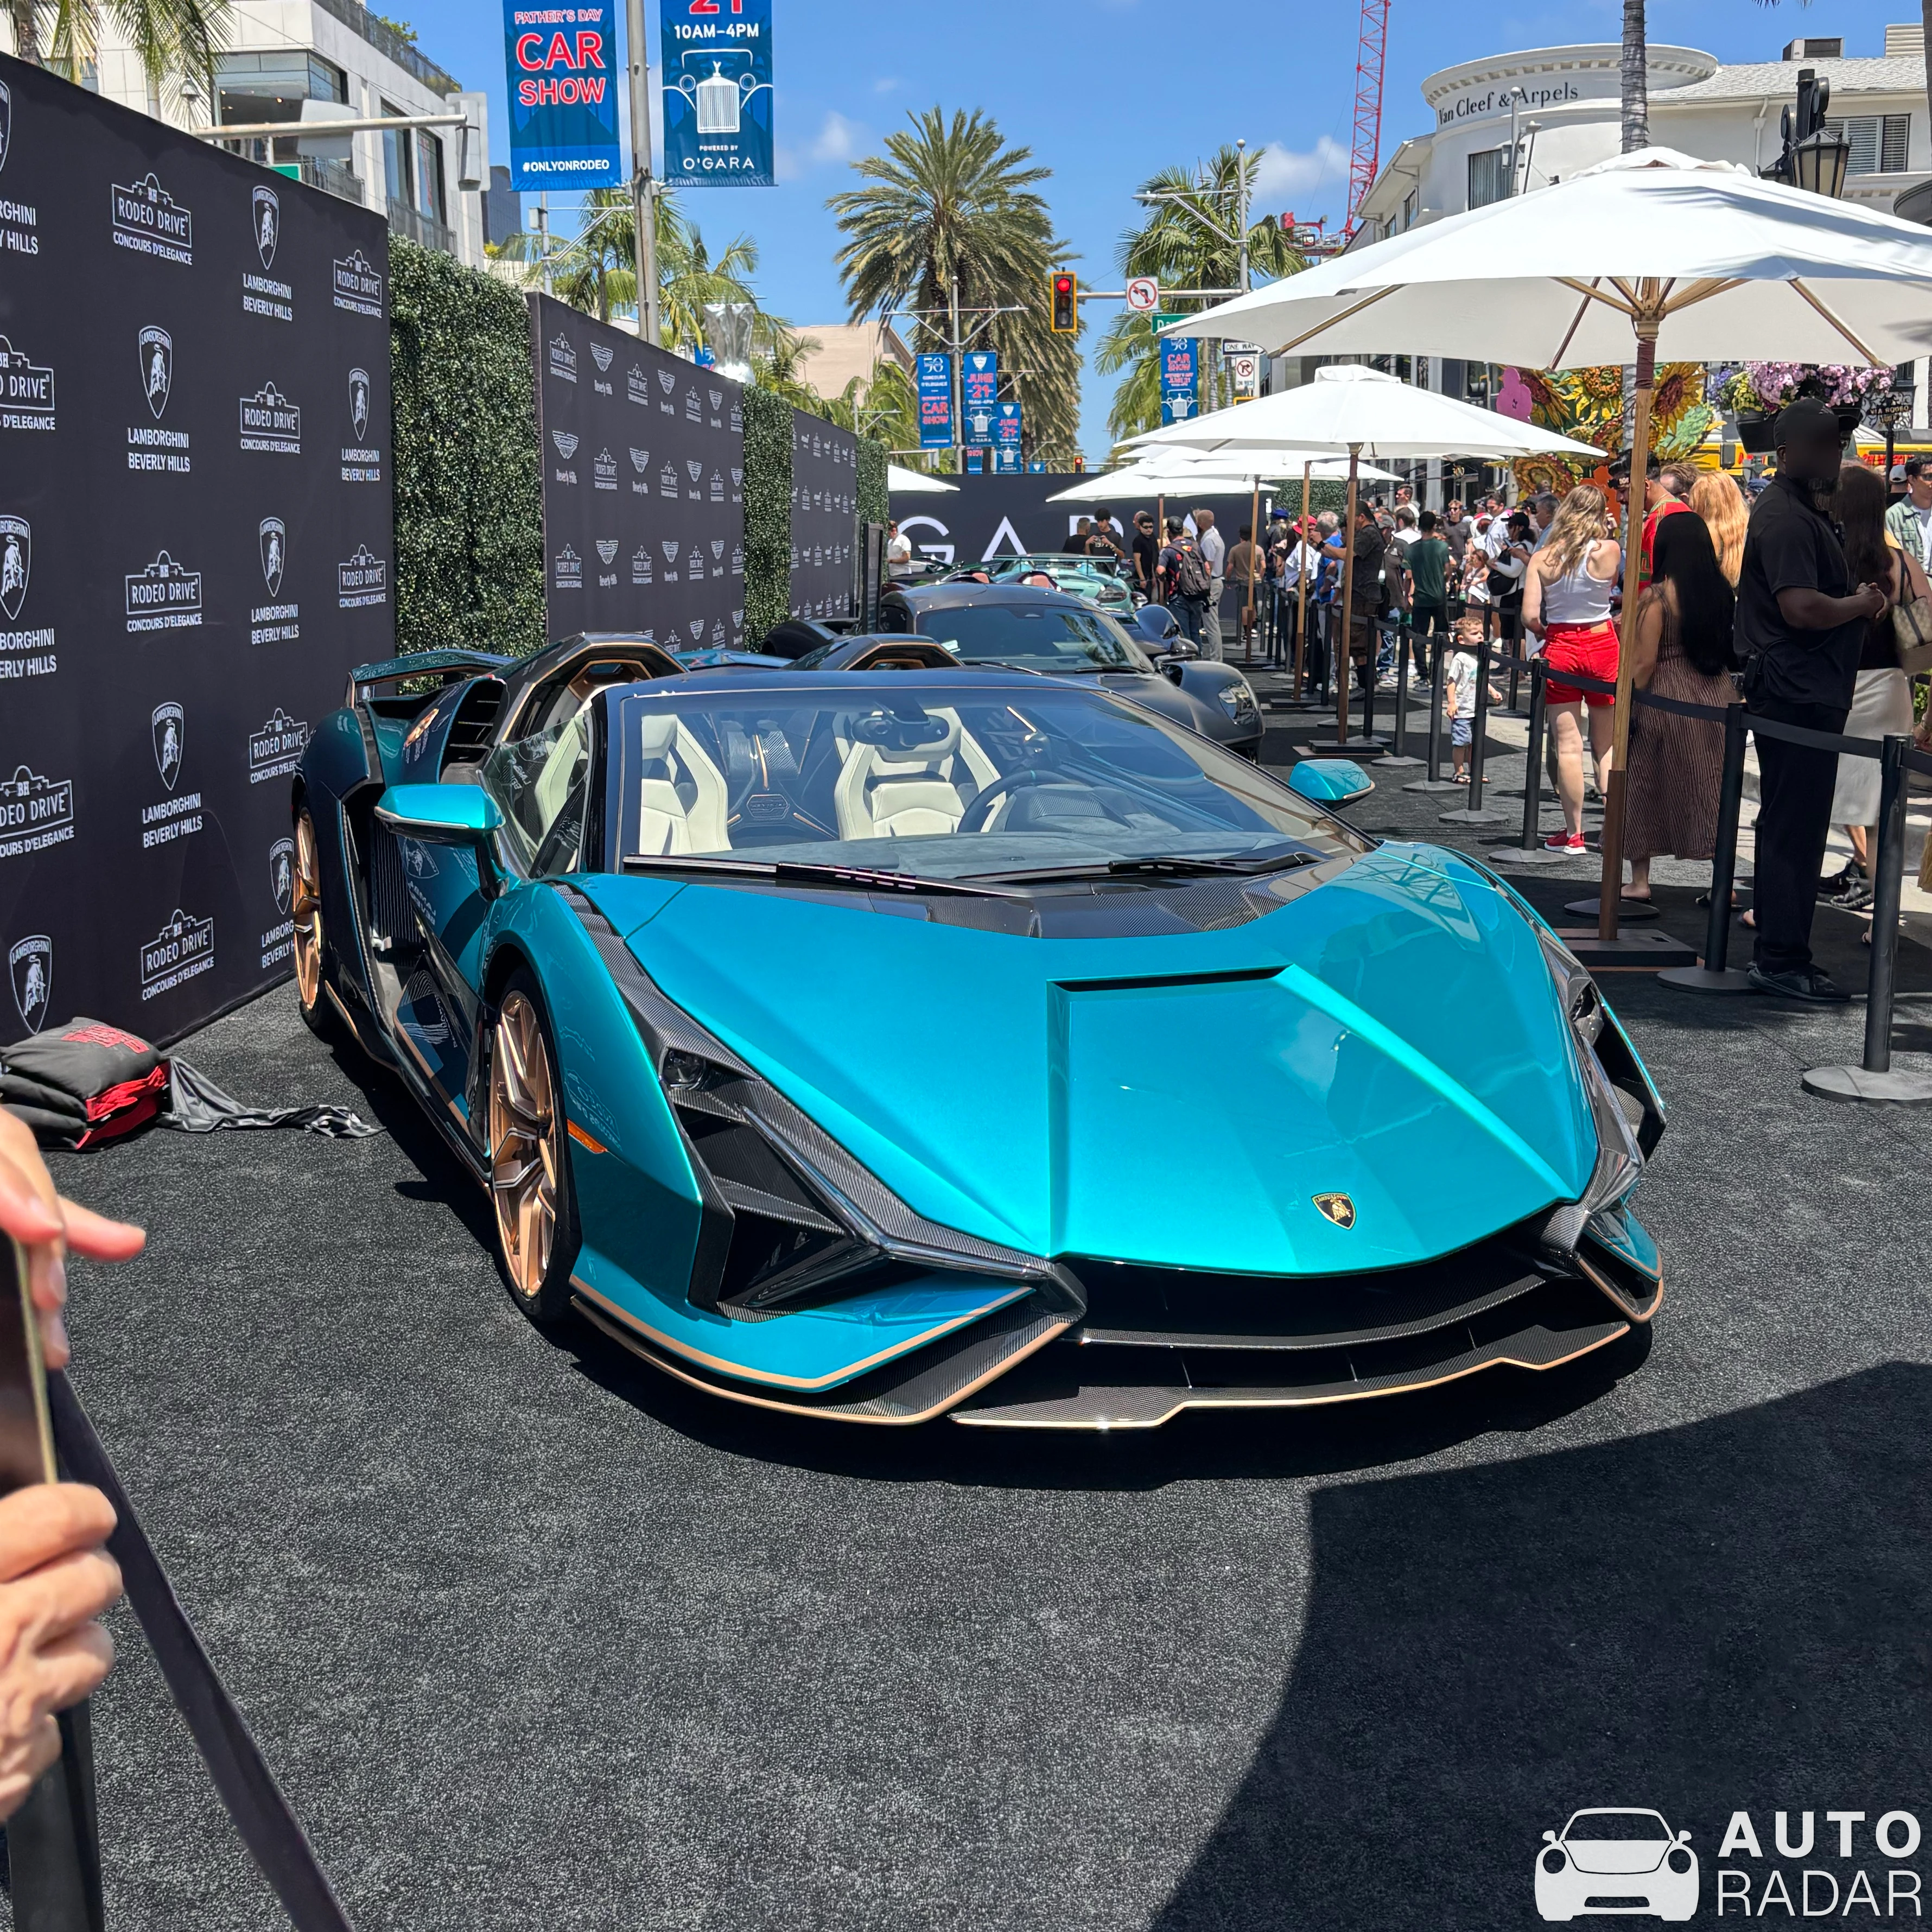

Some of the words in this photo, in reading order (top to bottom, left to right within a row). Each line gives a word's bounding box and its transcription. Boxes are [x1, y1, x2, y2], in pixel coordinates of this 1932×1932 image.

[514, 9, 575, 24] FATHER'S
[578, 9, 603, 22] DAY
[516, 31, 606, 71] CAR
[518, 77, 606, 106] SHOW
[1439, 107, 1454, 125] Van
[1457, 92, 1494, 117] Cleef
[1498, 93, 1511, 107] &
[1518, 82, 1579, 107] Arpels
[523, 160, 610, 172] #ONLYONRODEO
[683, 157, 755, 170] O'GARA
[118, 197, 154, 225] RODEO
[157, 209, 187, 237] DRIVE
[7, 231, 39, 255] HILLS
[113, 232, 152, 252] CONCOURS
[152, 243, 193, 265] D'ELEGANCE
[243, 273, 292, 300] LAMBORGHINI
[338, 269, 359, 291] RODEO
[243, 295, 275, 316] BEVERLY
[274, 303, 293, 321] HILLS
[10, 374, 48, 399] DRIVE
[967, 373, 994, 383] JUNE
[245, 408, 271, 428] RODEO
[274, 412, 297, 430] DRIVE
[921, 402, 949, 415] CAR
[3, 415, 56, 430] D'ELEGANCE
[128, 427, 189, 448] LAMBORGHINI
[240, 438, 269, 452] CONCOURS
[128, 452, 166, 471] BEVERLY
[167, 455, 190, 472] HILLS
[341, 448, 380, 462] LAMBORGHINI
[341, 467, 365, 481] BEVERLY
[365, 468, 380, 481] HILLS
[342, 571, 363, 586] RODEO
[132, 583, 166, 604] RODEO
[169, 581, 197, 601] DRIVE
[127, 617, 163, 632] CONCOURS
[164, 613, 202, 628] D'ELEGANCE
[251, 604, 298, 623] LAMBORGHINI
[251, 626, 281, 645] BEVERLY
[281, 624, 299, 640] HILLS
[27, 654, 57, 677] HILLS
[254, 736, 279, 759] RODEO
[282, 730, 304, 750] DRIVE
[250, 766, 278, 784] CONCOURS
[16, 781, 30, 797] BH
[30, 792, 67, 821] DRIVE
[143, 792, 201, 824] LAMBORGHINI
[24, 825, 75, 853] D'ELEGANCE
[143, 819, 180, 848] BEVERLY
[180, 815, 203, 836] HILLS
[146, 944, 179, 973] RODEO
[182, 927, 209, 956] DRIVE
[262, 943, 290, 969] BEVERLY
[142, 976, 177, 1001] CONCOURS
[177, 956, 214, 984] D'ELEGANCE
